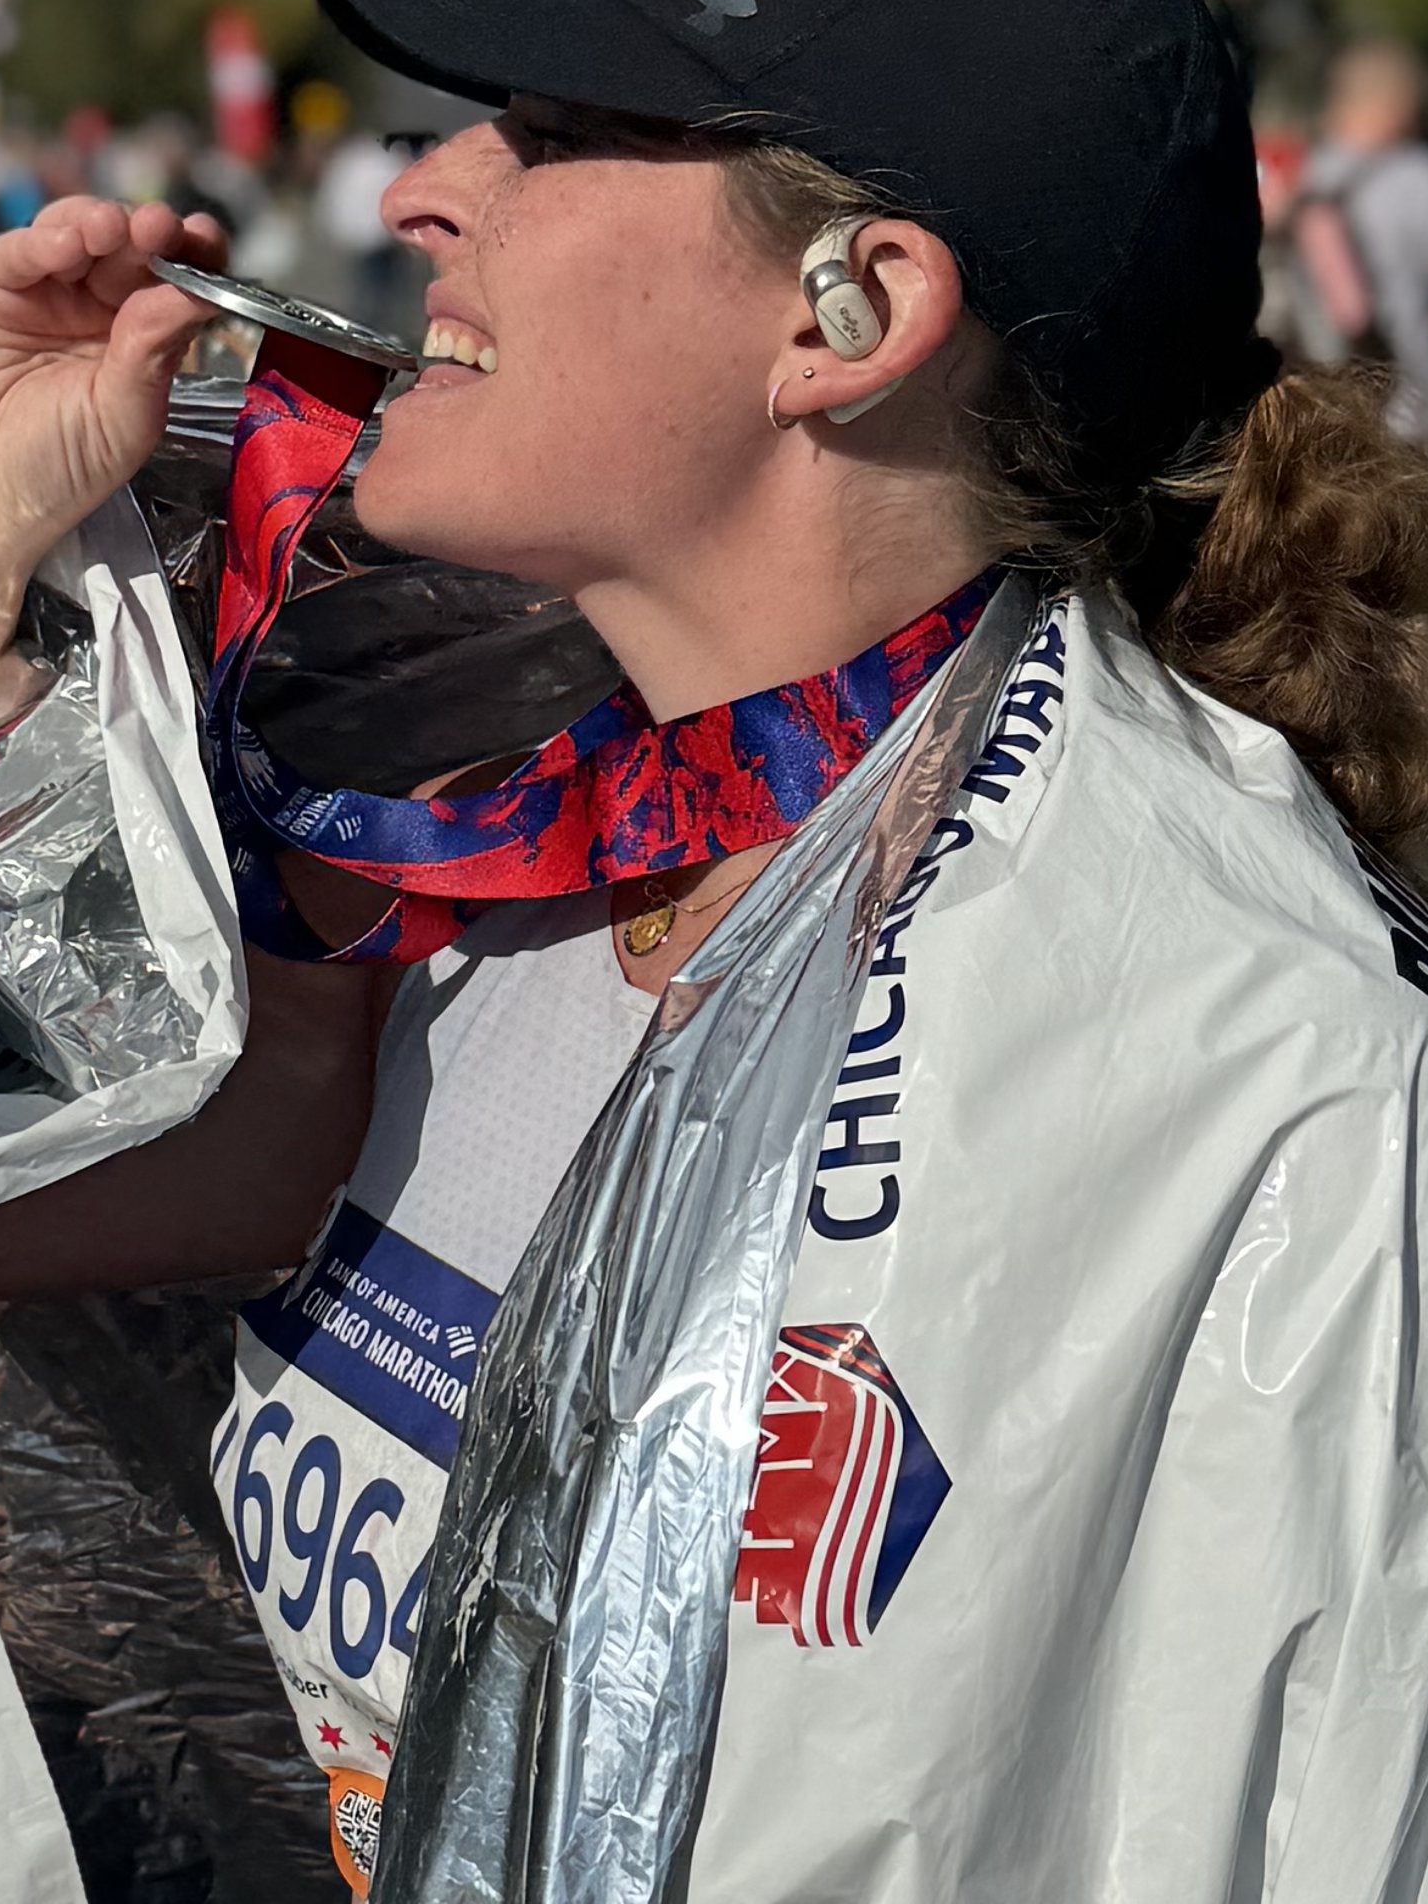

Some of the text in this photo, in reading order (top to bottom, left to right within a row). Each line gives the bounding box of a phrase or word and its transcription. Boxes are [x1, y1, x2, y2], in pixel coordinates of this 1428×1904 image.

[302, 1286, 469, 1421] CHICAGO MARATHON
[326, 1257, 441, 1346] BANK OF AMERICA
